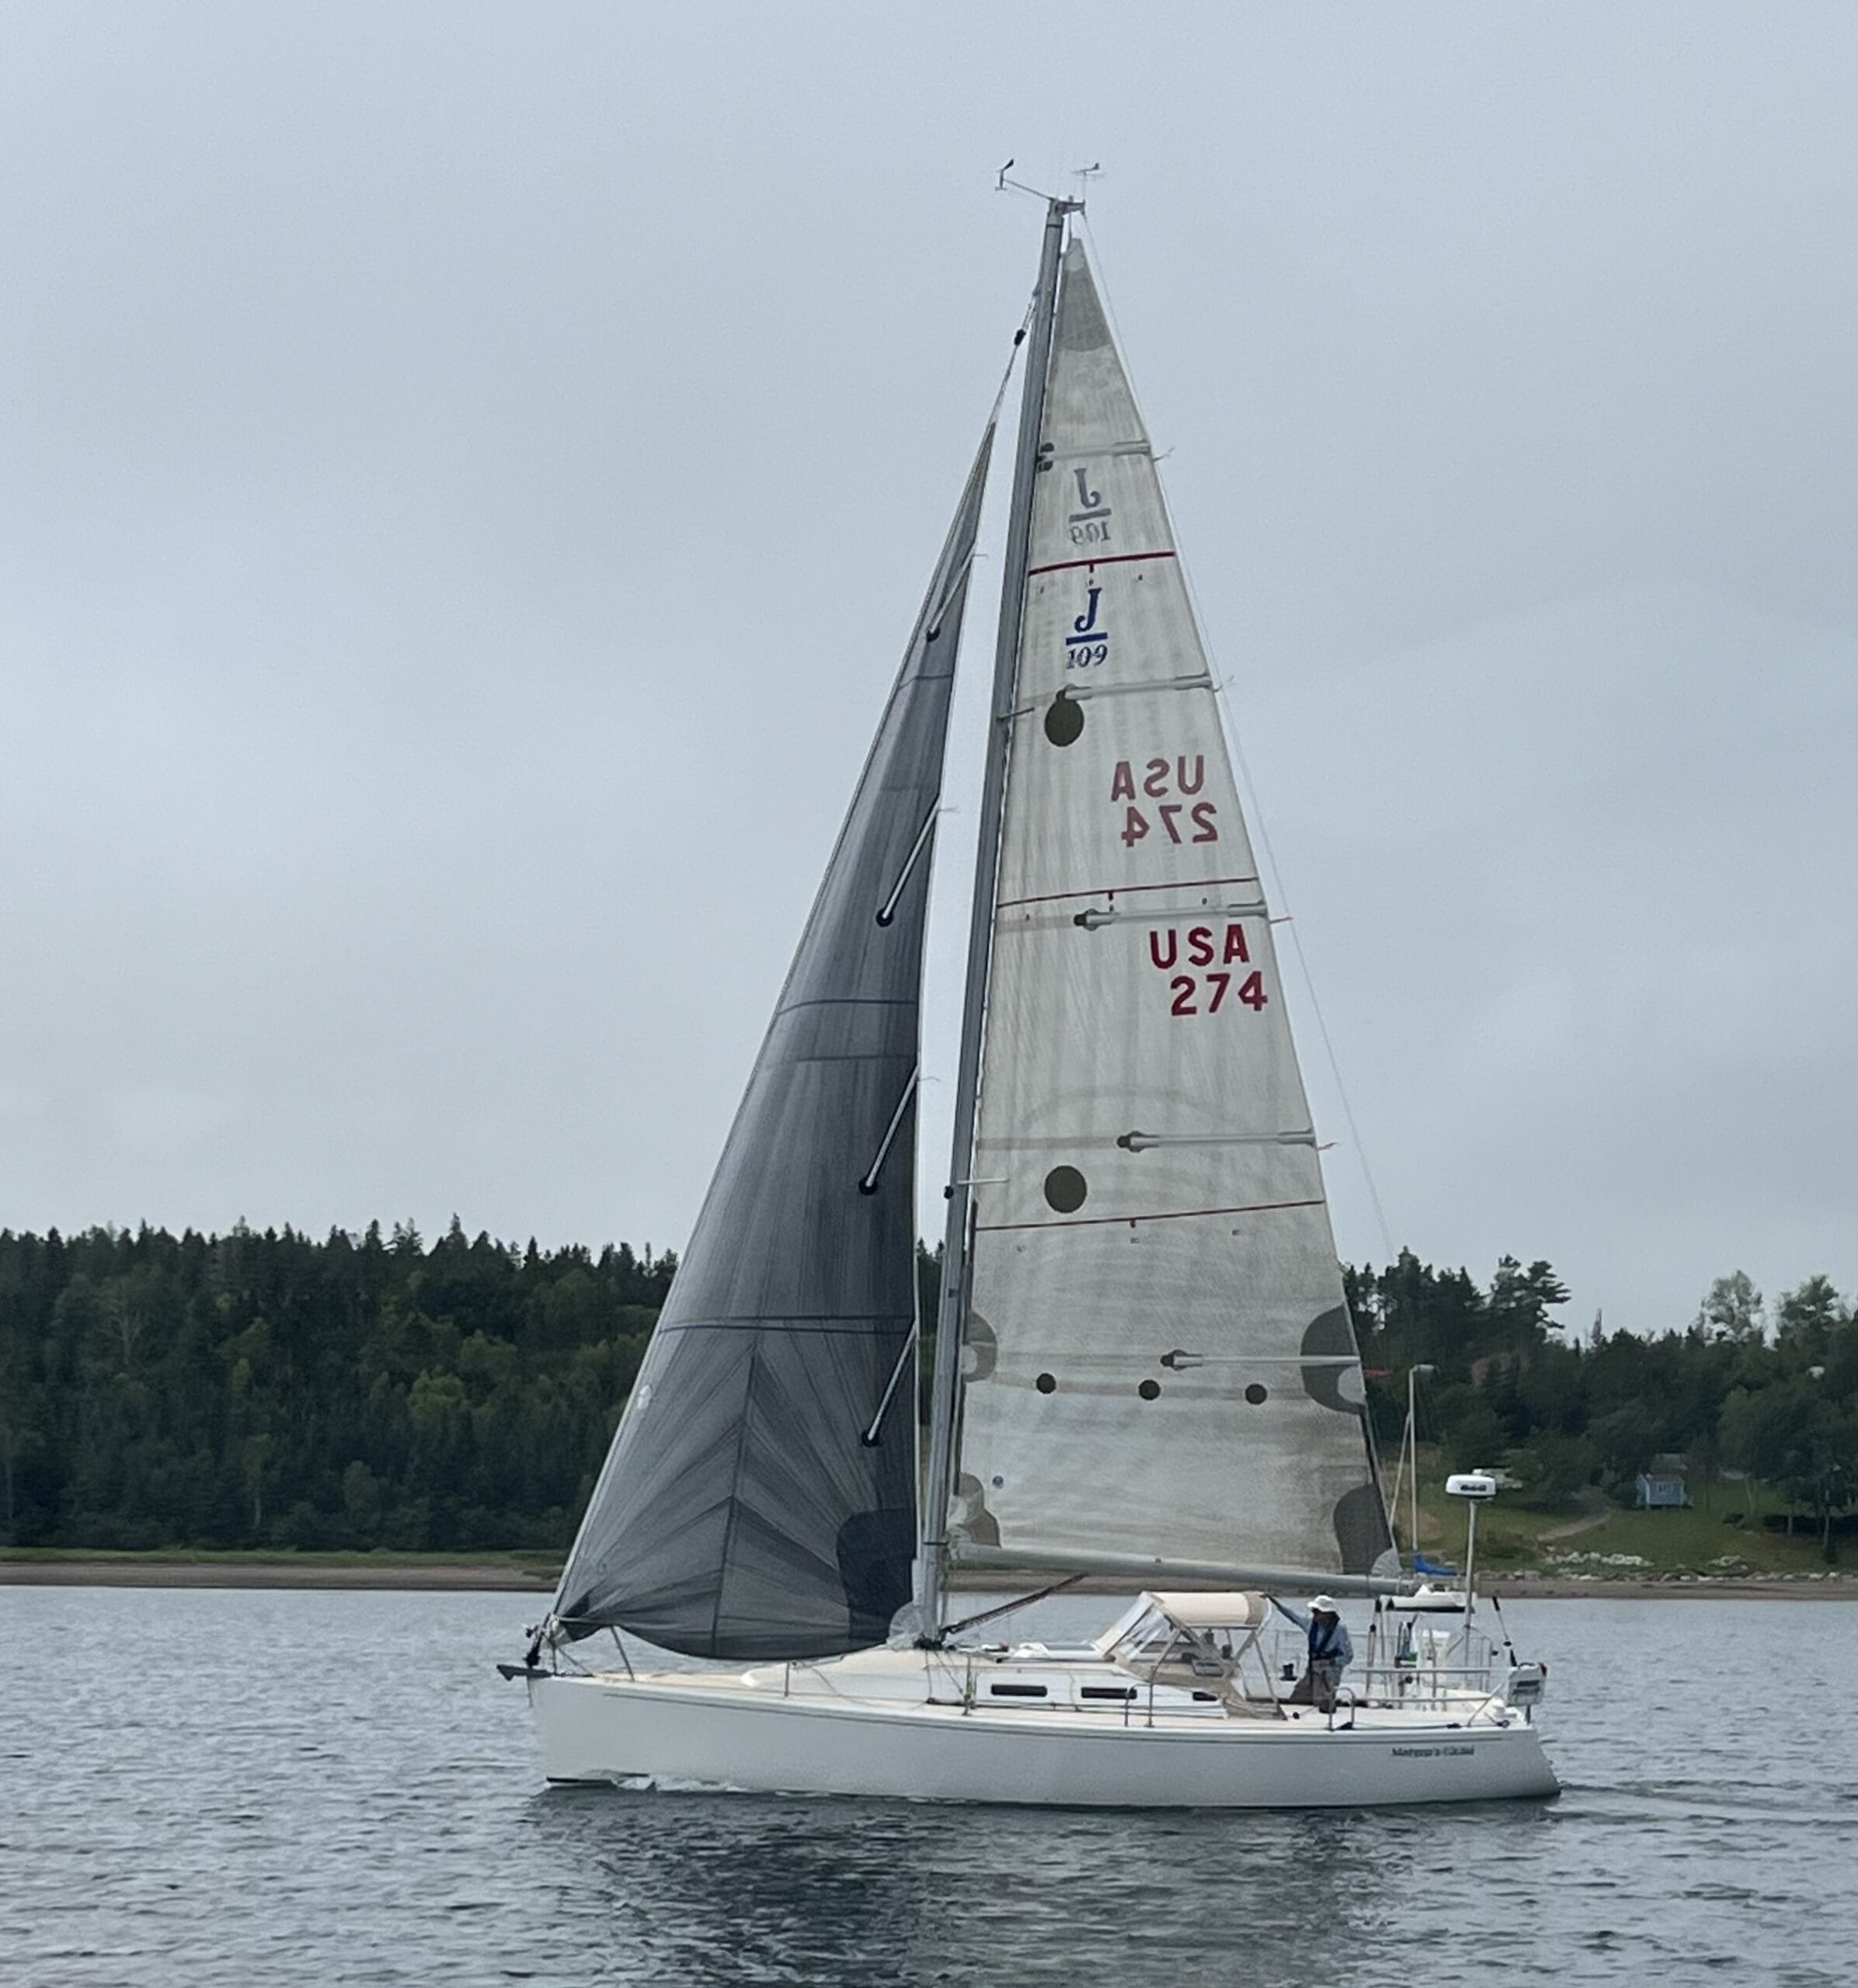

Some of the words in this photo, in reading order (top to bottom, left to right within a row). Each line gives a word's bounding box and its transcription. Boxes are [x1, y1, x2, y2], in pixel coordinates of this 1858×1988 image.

[1074, 587, 1101, 633] J
[1066, 644, 1108, 669] 109
[1150, 924, 1250, 969] USA
[1171, 971, 1268, 1016] 274
